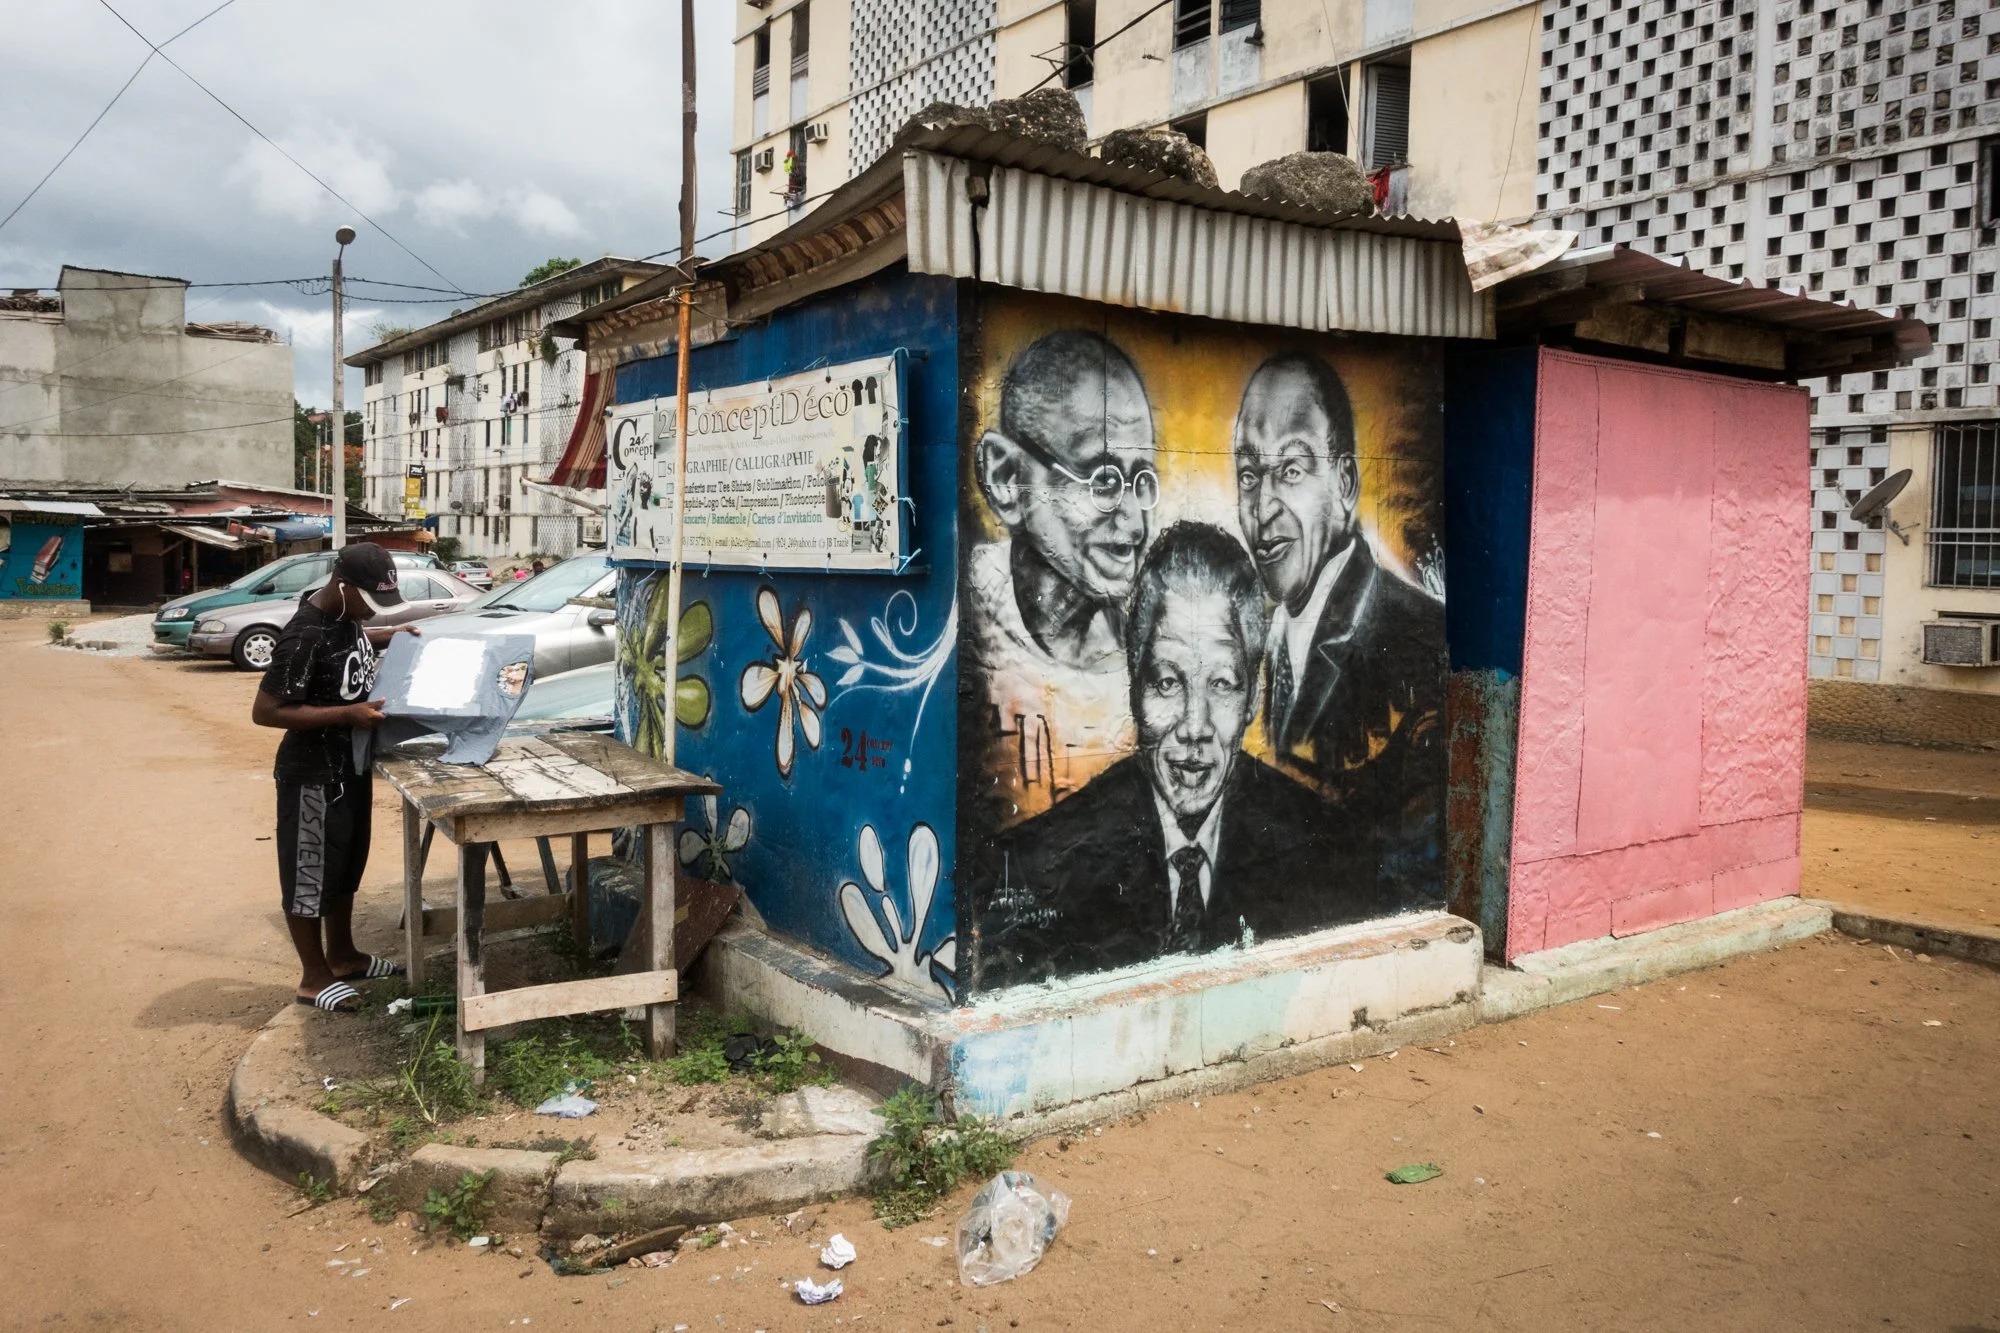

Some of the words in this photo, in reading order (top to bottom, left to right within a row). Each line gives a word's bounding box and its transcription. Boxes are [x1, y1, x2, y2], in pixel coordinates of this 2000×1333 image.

[735, 451, 813, 471] CALLIGRAPHIE
[718, 481, 730, 492] Tee
[757, 476, 801, 491] Sublimation
[741, 494, 779, 511] Impression
[785, 490, 825, 508] Photocopie
[712, 511, 747, 525] Banderole
[752, 511, 776, 525] Cartes
[841, 727, 868, 772] 24
